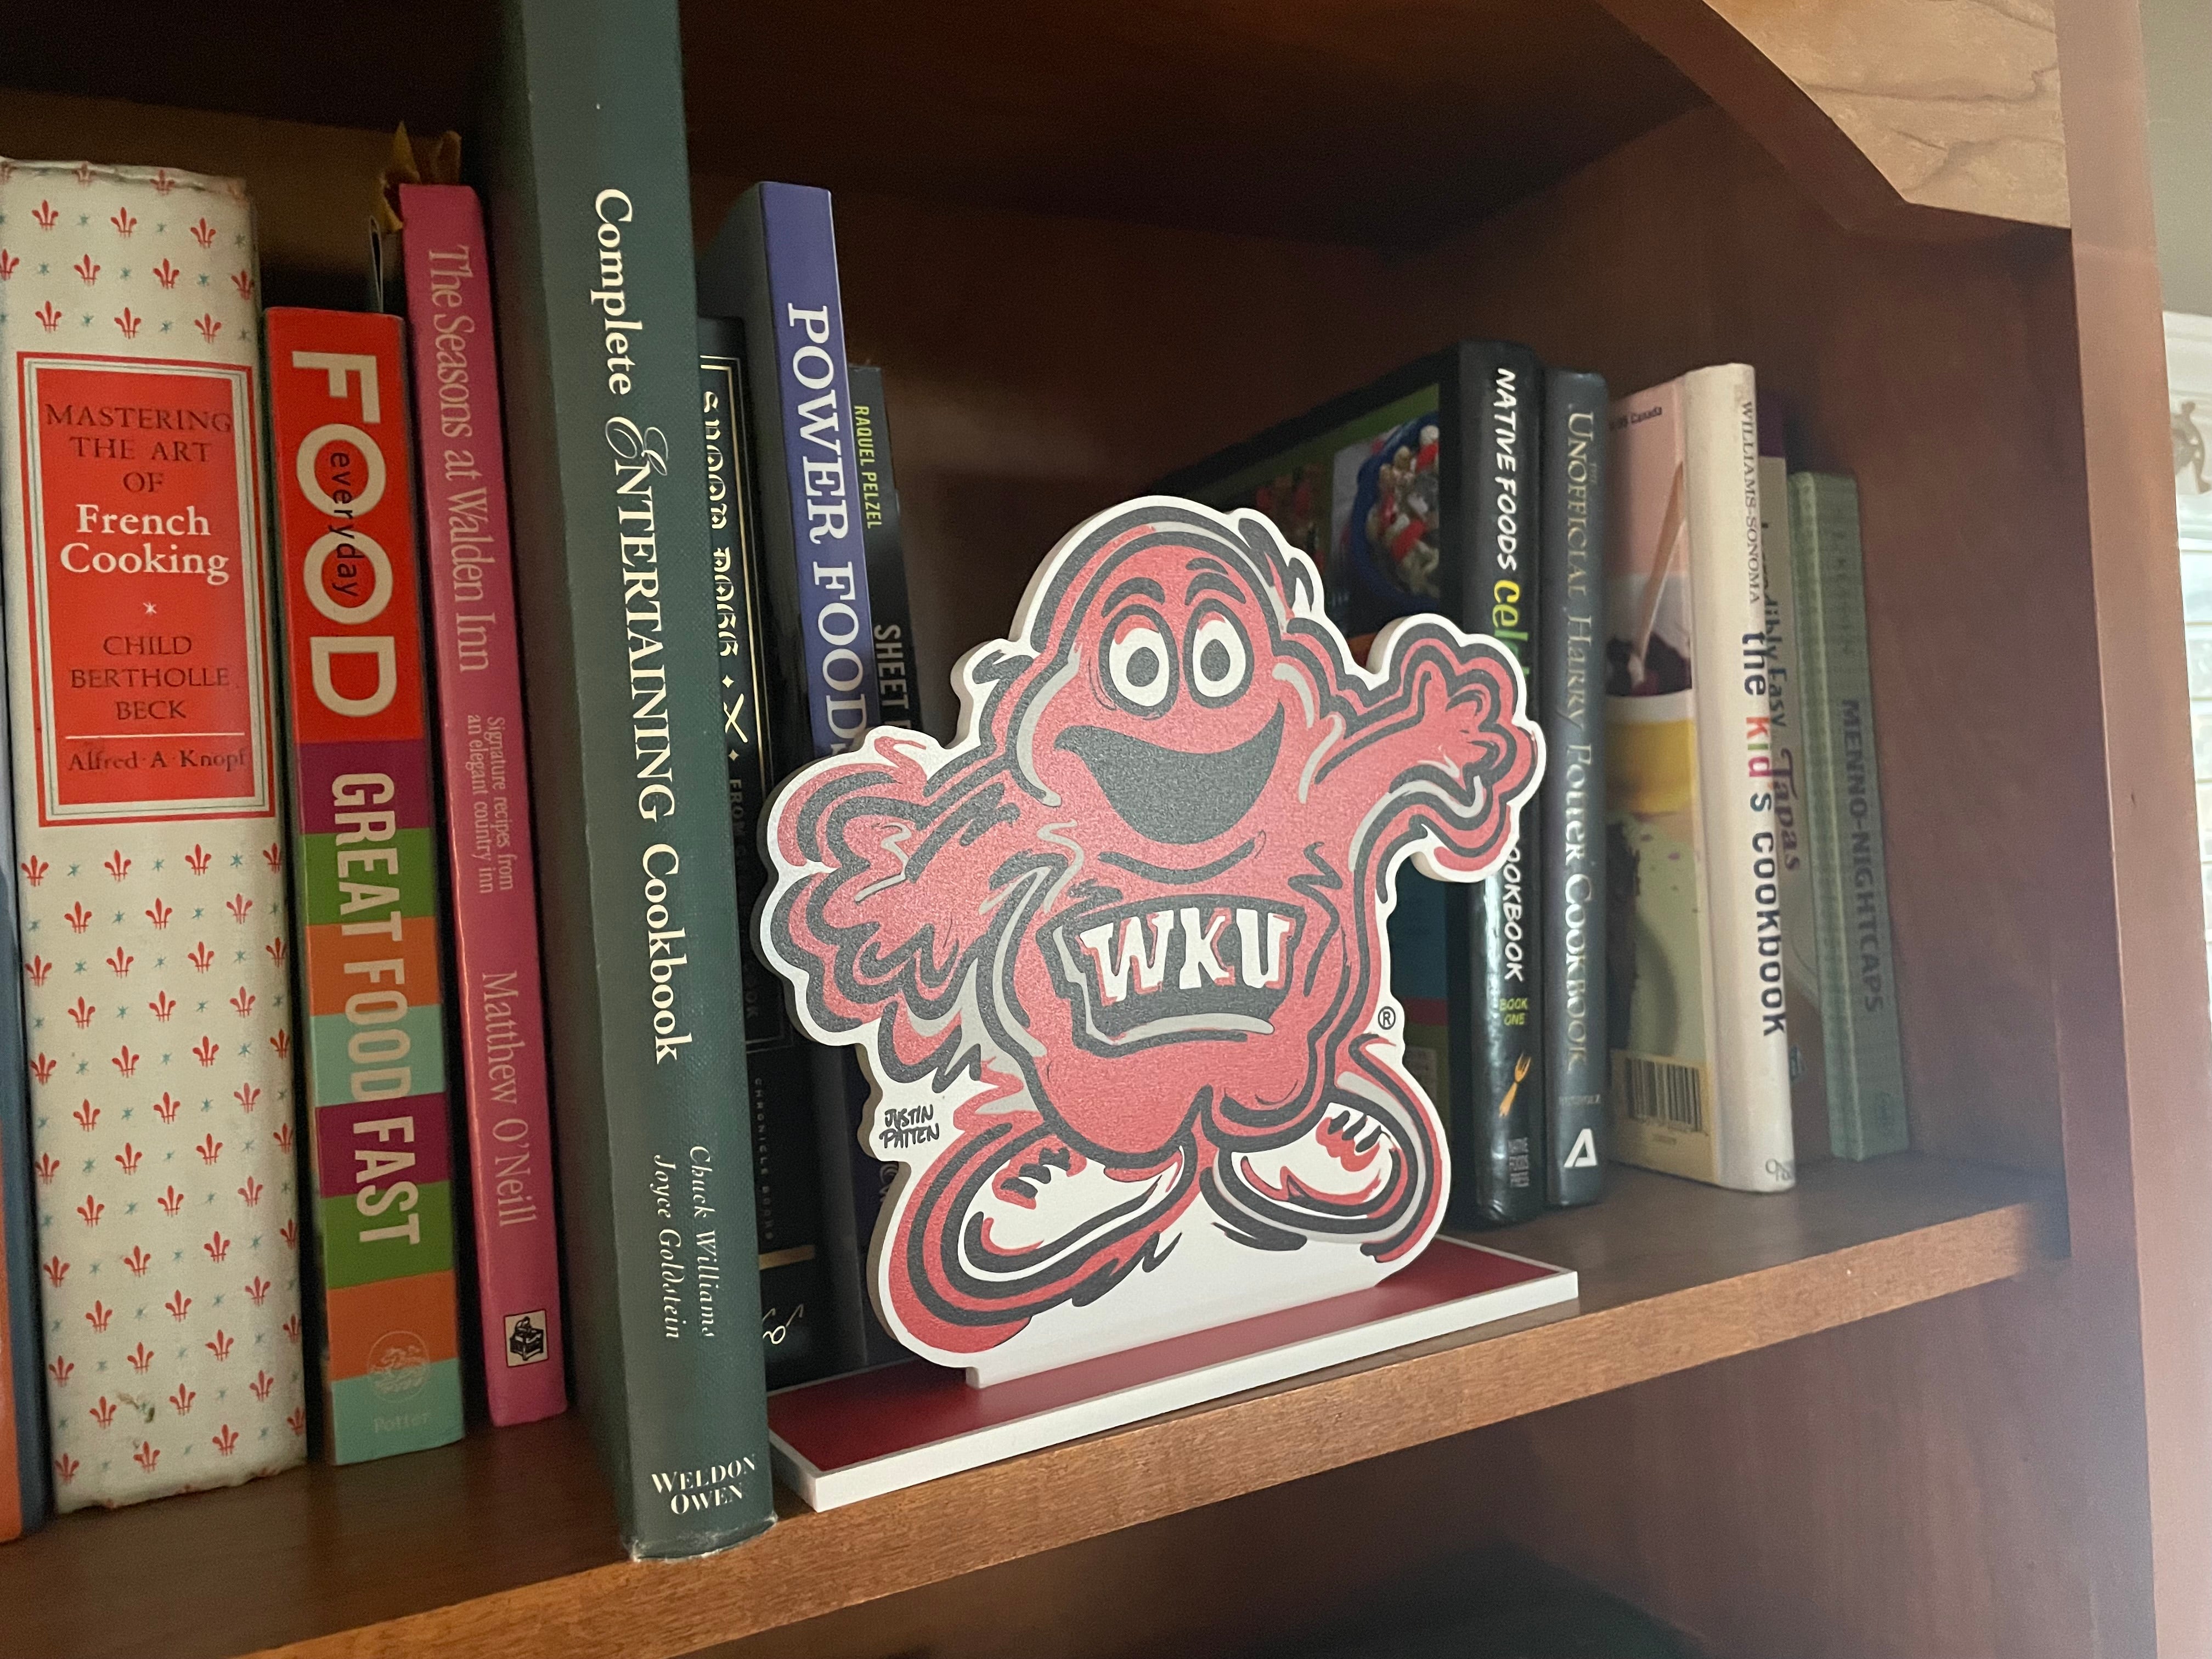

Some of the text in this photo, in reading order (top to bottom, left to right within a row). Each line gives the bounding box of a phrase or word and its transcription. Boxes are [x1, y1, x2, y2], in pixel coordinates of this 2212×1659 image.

[45, 404, 232, 433] MASTERING
[70, 437, 213, 461] THE ART
[428, 245, 496, 673] The Seasons at Walden Inn
[123, 471, 163, 493] OF
[854, 405, 882, 529] RAQUEL PELZEL
[1493, 367, 1517, 571] NATIVE FOODS
[1567, 411, 1594, 597] UNOFFICIAL
[1741, 401, 1761, 605] WILLIAMS-SONOMA
[59, 543, 230, 586] Cooking
[76, 504, 211, 536] French
[292, 351, 397, 717] FOOD
[329, 451, 365, 597] everyday
[788, 302, 868, 755] POWER FOOD
[103, 635, 193, 656] CHILD
[590, 188, 642, 396] Complete
[642, 843, 693, 1065] Cookbook
[873, 624, 909, 710] SHEET
[1742, 631, 1766, 696] the
[70, 669, 229, 689] BERTHOLLE
[116, 699, 187, 720] BECK
[68, 749, 246, 771] Alfred A Knopf
[465, 714, 496, 894] an elegant country inn
[483, 716, 517, 890] Signature recipes from
[1840, 698, 1885, 1013] MENNO-NIGHTCAPS
[1076, 907, 1295, 1005] WKU
[331, 772, 420, 1245] GREAT FOOD FAST
[1499, 997, 1528, 1011] BOOK
[1504, 1013, 1525, 1026] ONE
[482, 970, 538, 1227] Matthew O'Neill
[878, 1122, 940, 1149] PATTEN
[884, 1104, 934, 1128] JUSTIN
[650, 1154, 687, 1339] Joyce Goldstein
[689, 1145, 720, 1338] Chuck Williams
[651, 1454, 757, 1494] WELDON
[670, 1483, 744, 1516] OWEN
